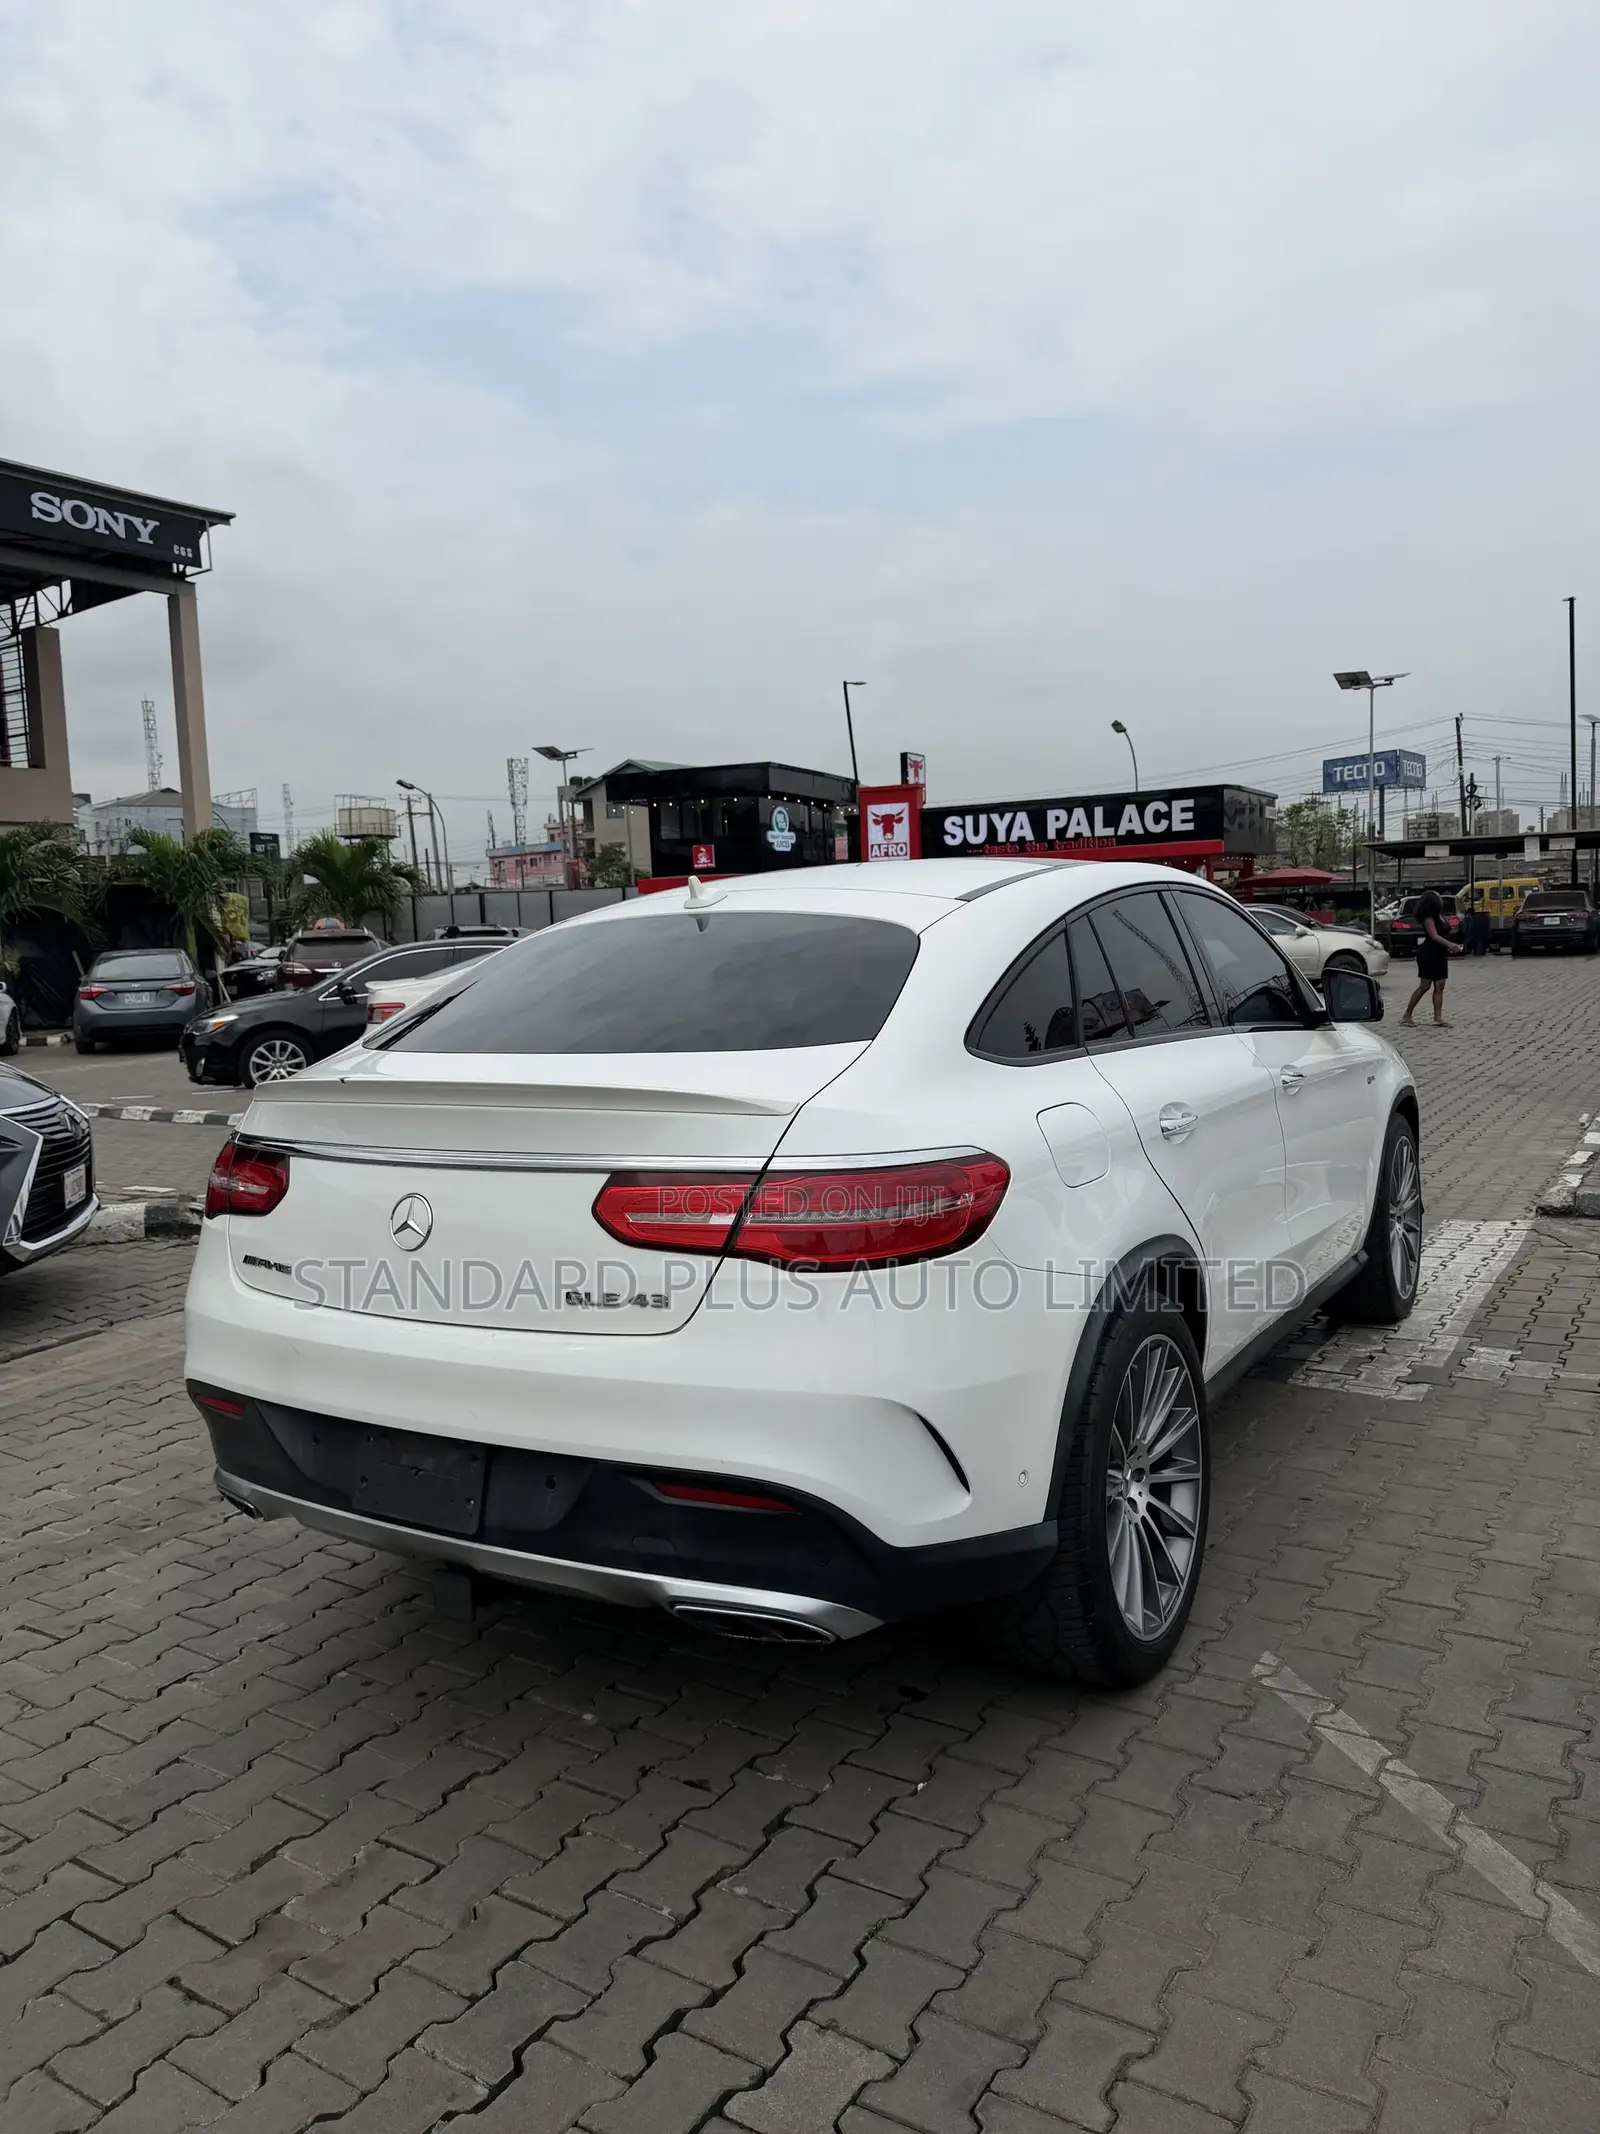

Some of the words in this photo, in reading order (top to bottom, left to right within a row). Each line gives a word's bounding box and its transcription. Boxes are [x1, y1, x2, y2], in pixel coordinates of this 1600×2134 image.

[30, 491, 160, 544] SONY
[1333, 761, 1386, 782] TECNO
[1402, 760, 1423, 777] TECNO
[943, 811, 1034, 846] SUYA
[1046, 799, 1195, 839] PALACE
[871, 843, 907, 857] AFRO
[1025, 840, 1048, 852] the
[1053, 837, 1116, 851] tradition
[628, 1293, 669, 1309] 43
